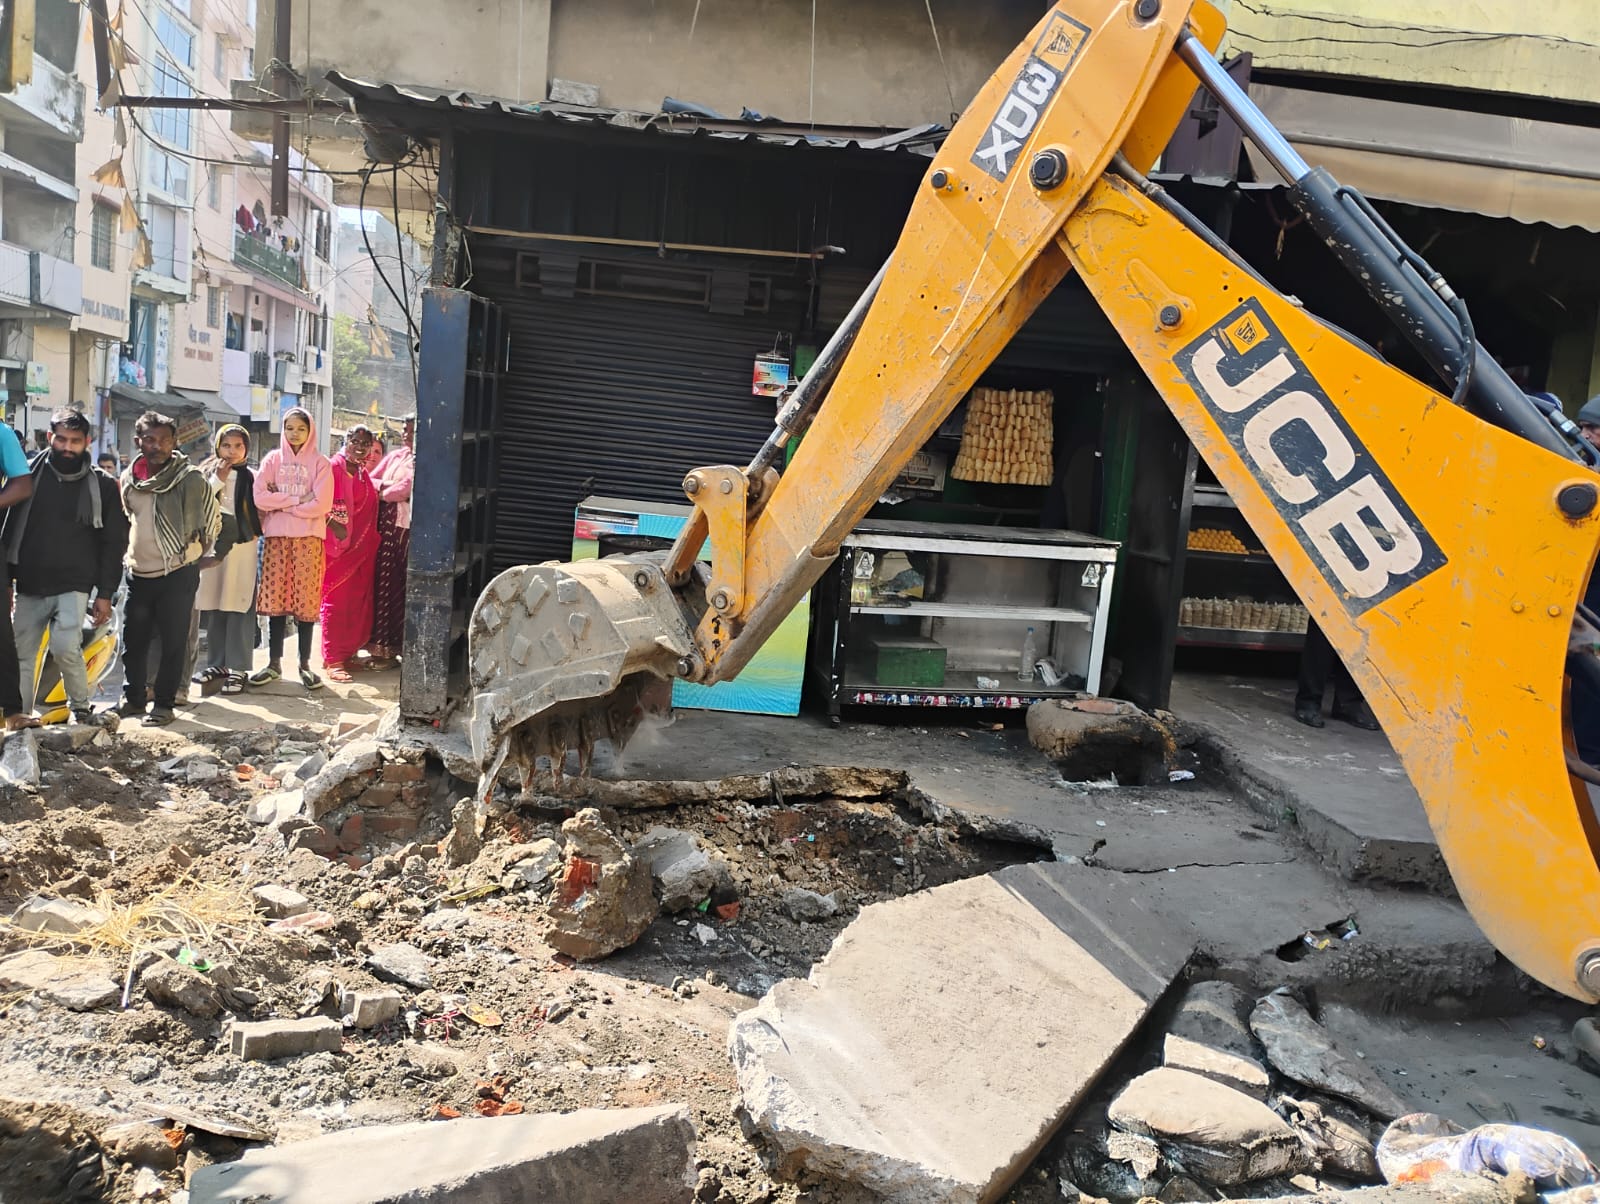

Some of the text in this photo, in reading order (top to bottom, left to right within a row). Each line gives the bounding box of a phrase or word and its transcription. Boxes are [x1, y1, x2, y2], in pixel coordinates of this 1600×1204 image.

[975, 61, 1057, 174] 3DX
[1237, 321, 1256, 343] JCB
[1191, 337, 1423, 599] JCB
